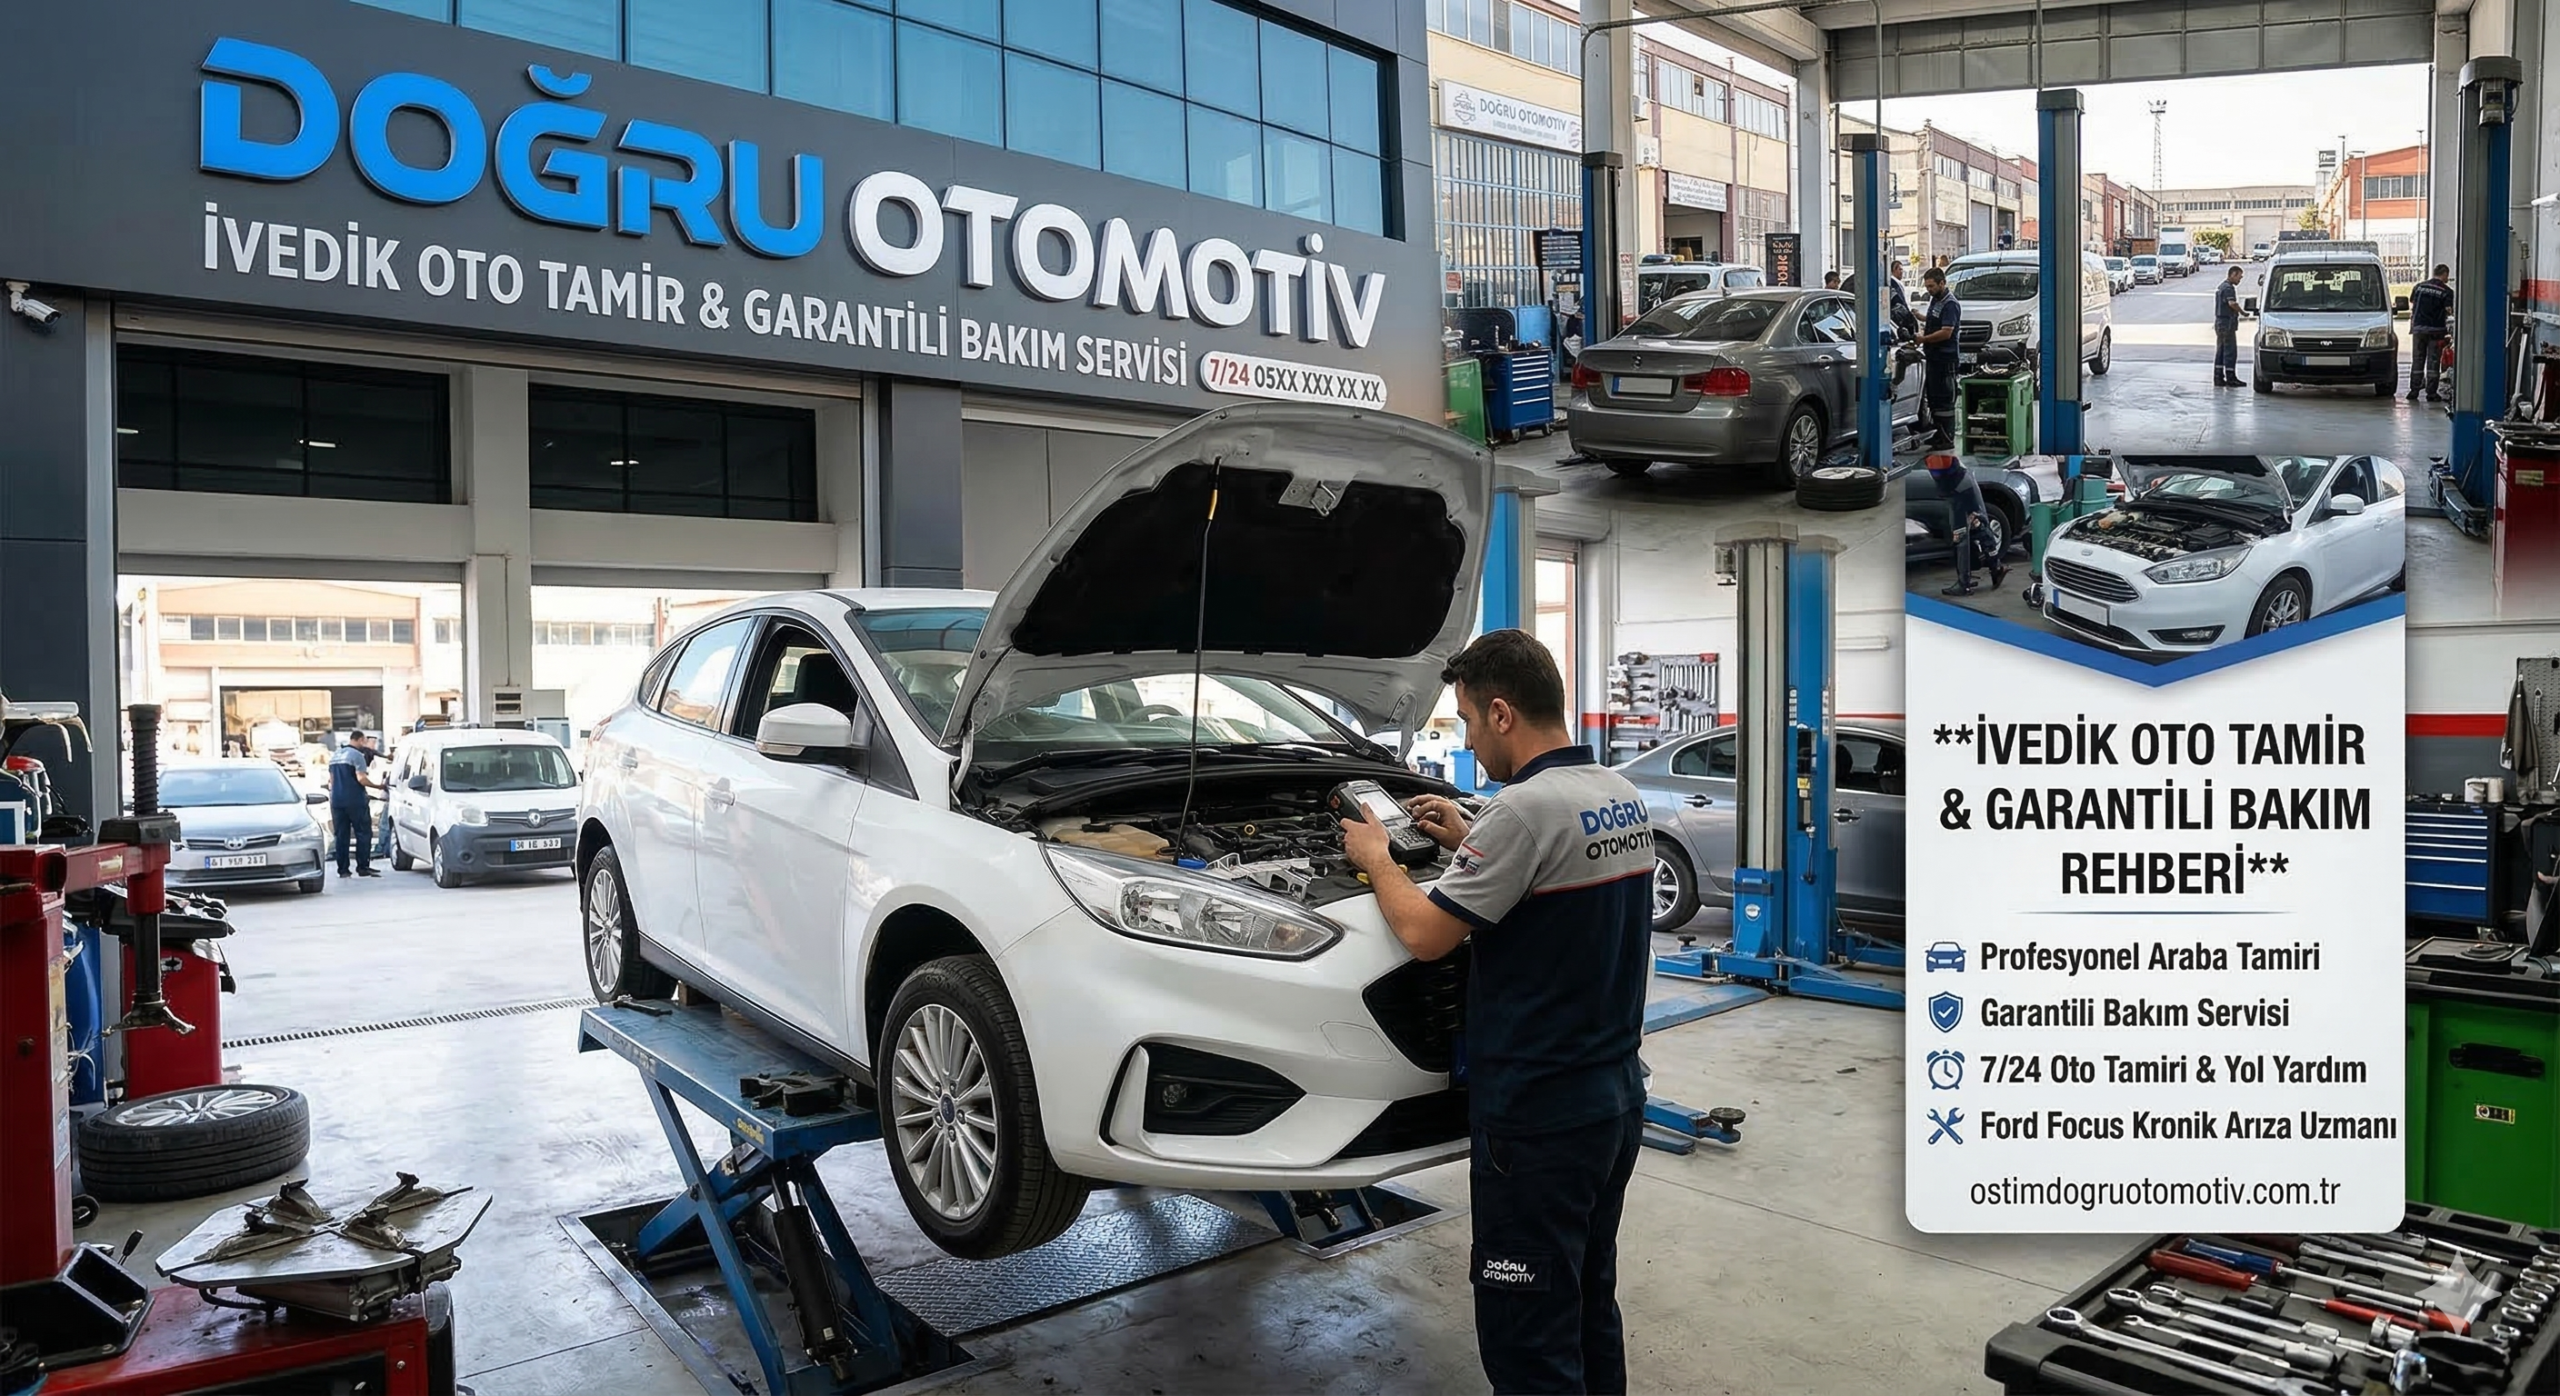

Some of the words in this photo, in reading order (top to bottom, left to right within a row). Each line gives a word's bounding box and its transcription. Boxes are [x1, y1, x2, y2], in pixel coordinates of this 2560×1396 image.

[199, 36, 825, 259] DOĞRU
[848, 170, 1387, 349] OTOMOTİV
[203, 201, 402, 291] İVEDİK
[417, 244, 524, 305] OTO
[538, 259, 686, 325] TAMİR
[698, 281, 730, 330] &
[743, 288, 948, 357] GARANTİLİ
[960, 318, 1067, 372] BAKIM
[1075, 334, 1188, 387] SERVİSİ
[1208, 357, 1251, 388] 7/24
[1254, 362, 1298, 393] 05XX
[1300, 369, 1335, 397] XXX
[1336, 373, 1358, 400] XX
[1359, 376, 1382, 402] XX
[1579, 798, 1649, 836] DOĞRU
